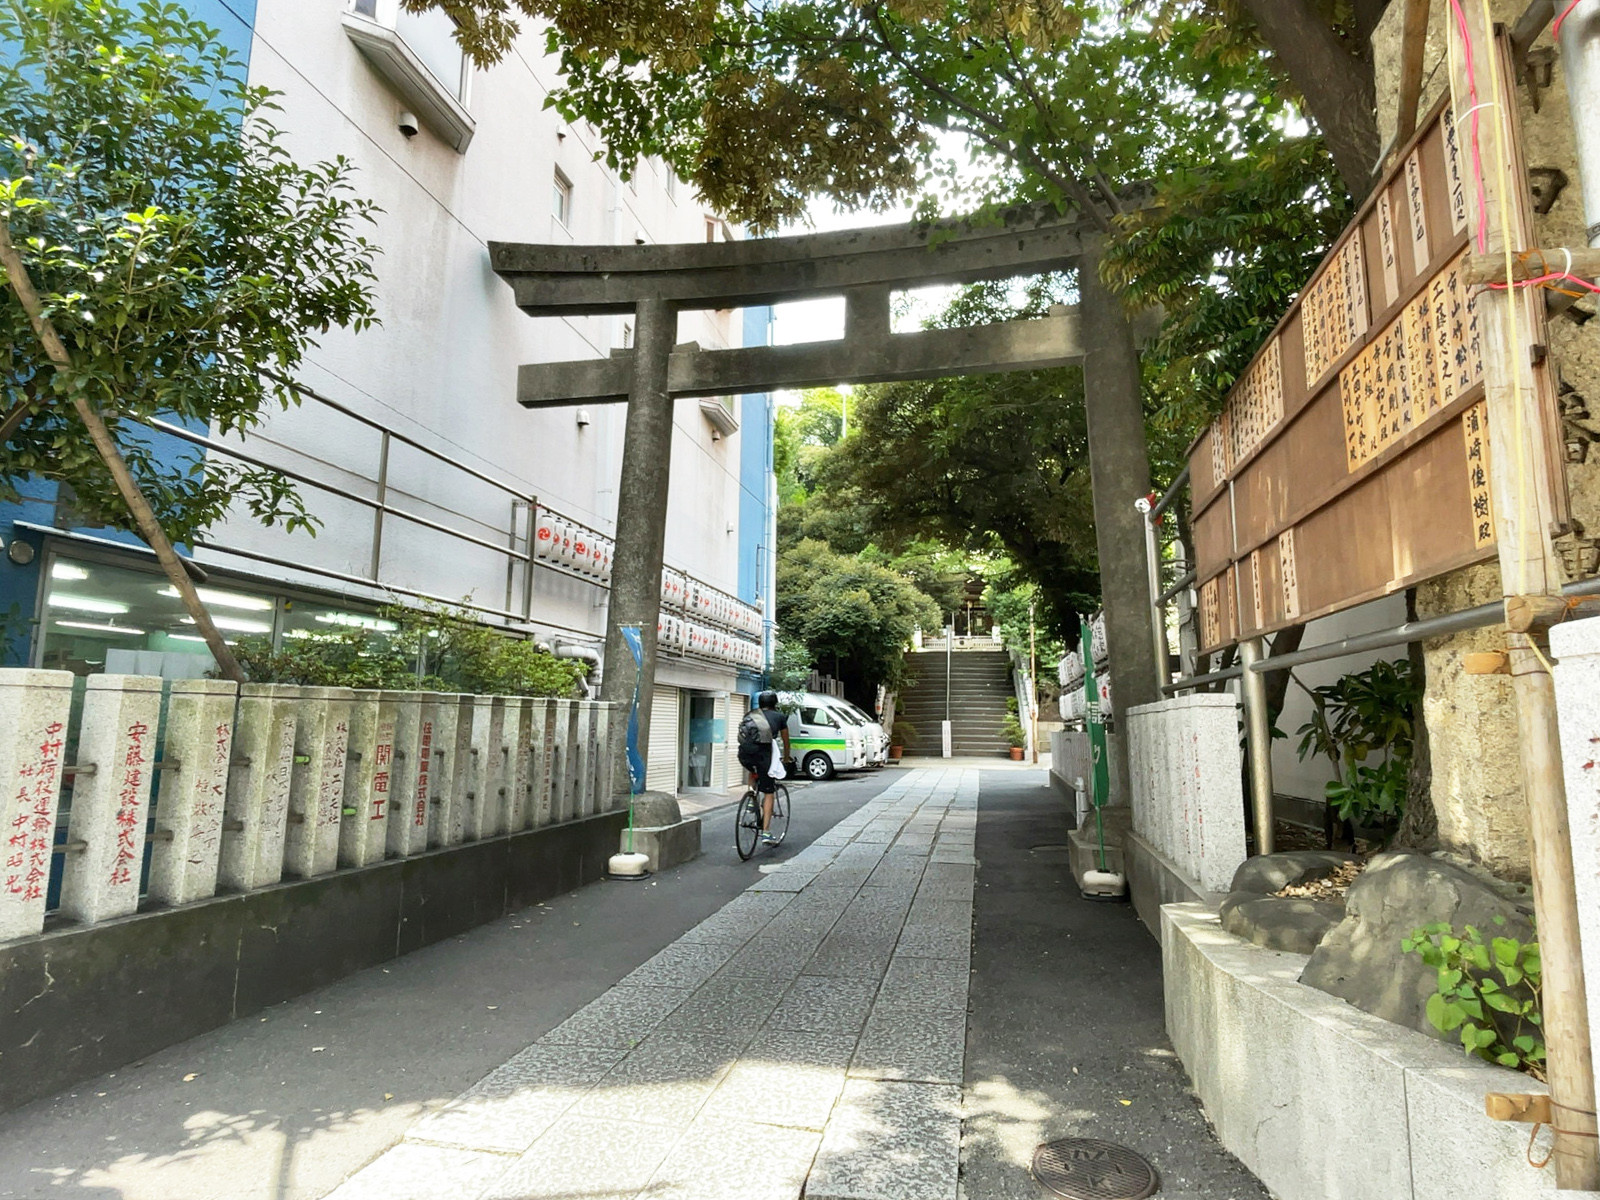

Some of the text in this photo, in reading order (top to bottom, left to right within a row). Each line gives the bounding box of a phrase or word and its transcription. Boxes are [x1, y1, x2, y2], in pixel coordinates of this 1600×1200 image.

[108, 721, 148, 886] 安藤建設株式会社
